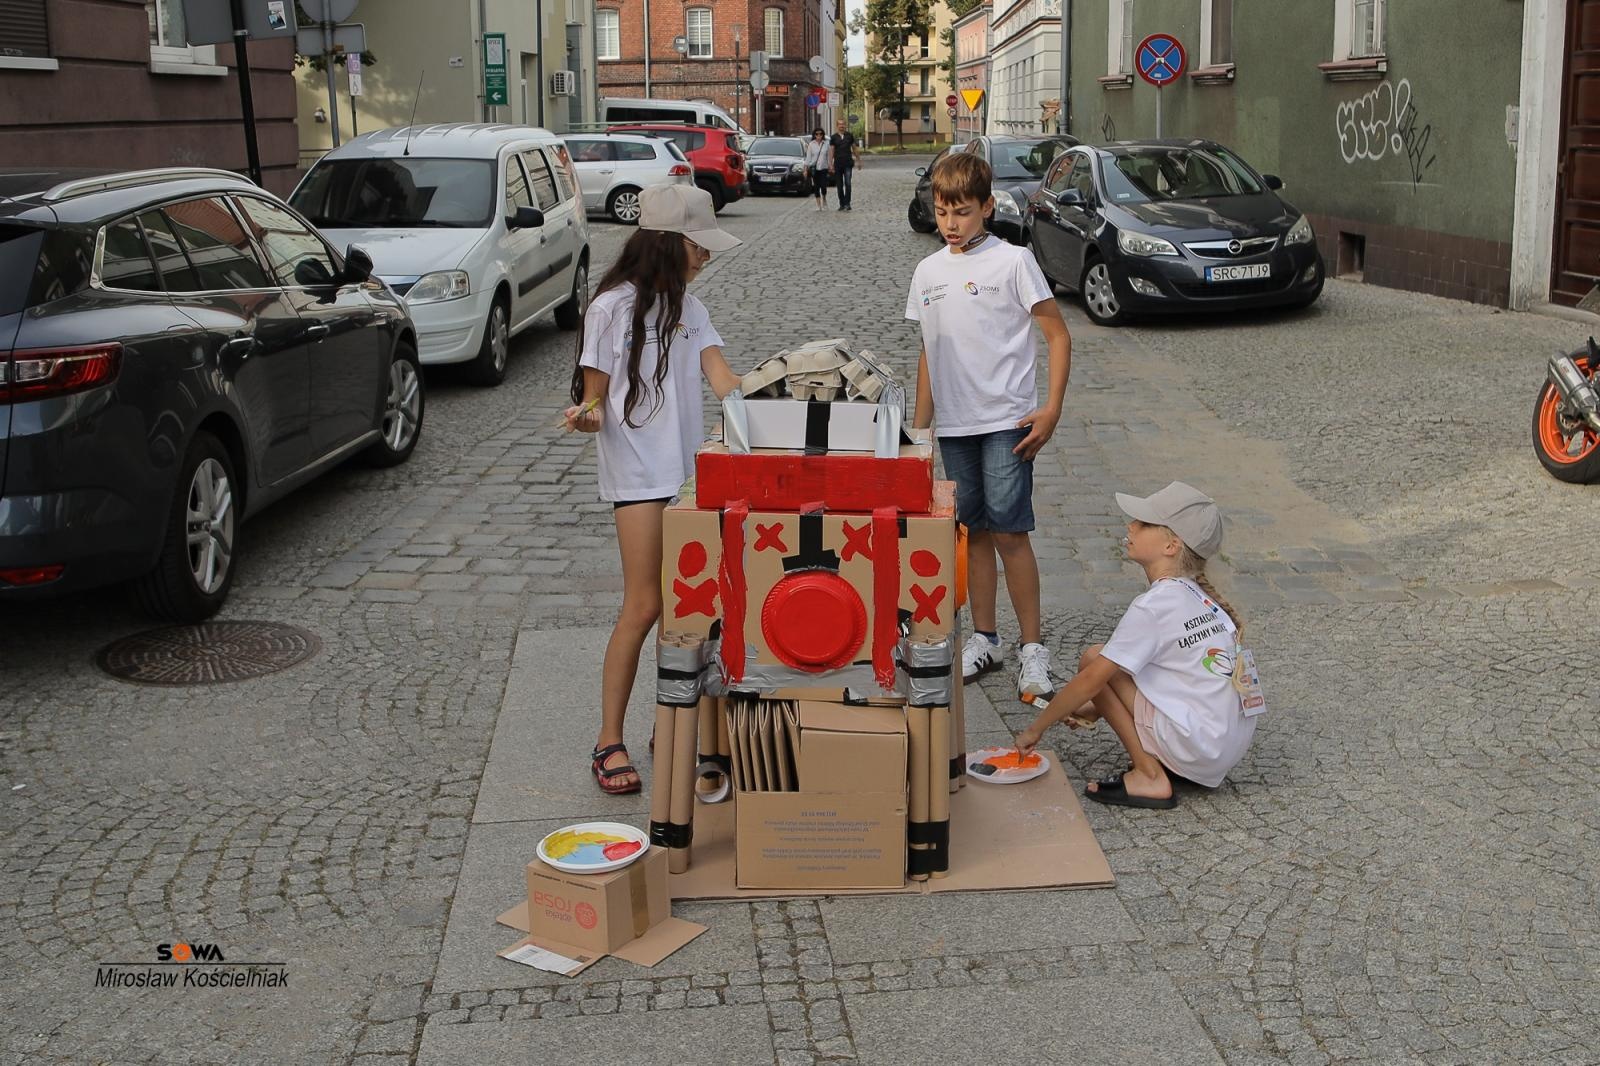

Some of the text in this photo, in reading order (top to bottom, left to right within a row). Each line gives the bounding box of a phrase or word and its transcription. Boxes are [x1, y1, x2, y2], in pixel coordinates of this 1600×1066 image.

[1213, 265, 1269, 280] SRC 7TJ9
[1178, 628, 1211, 648] ŁĄCZYMY
